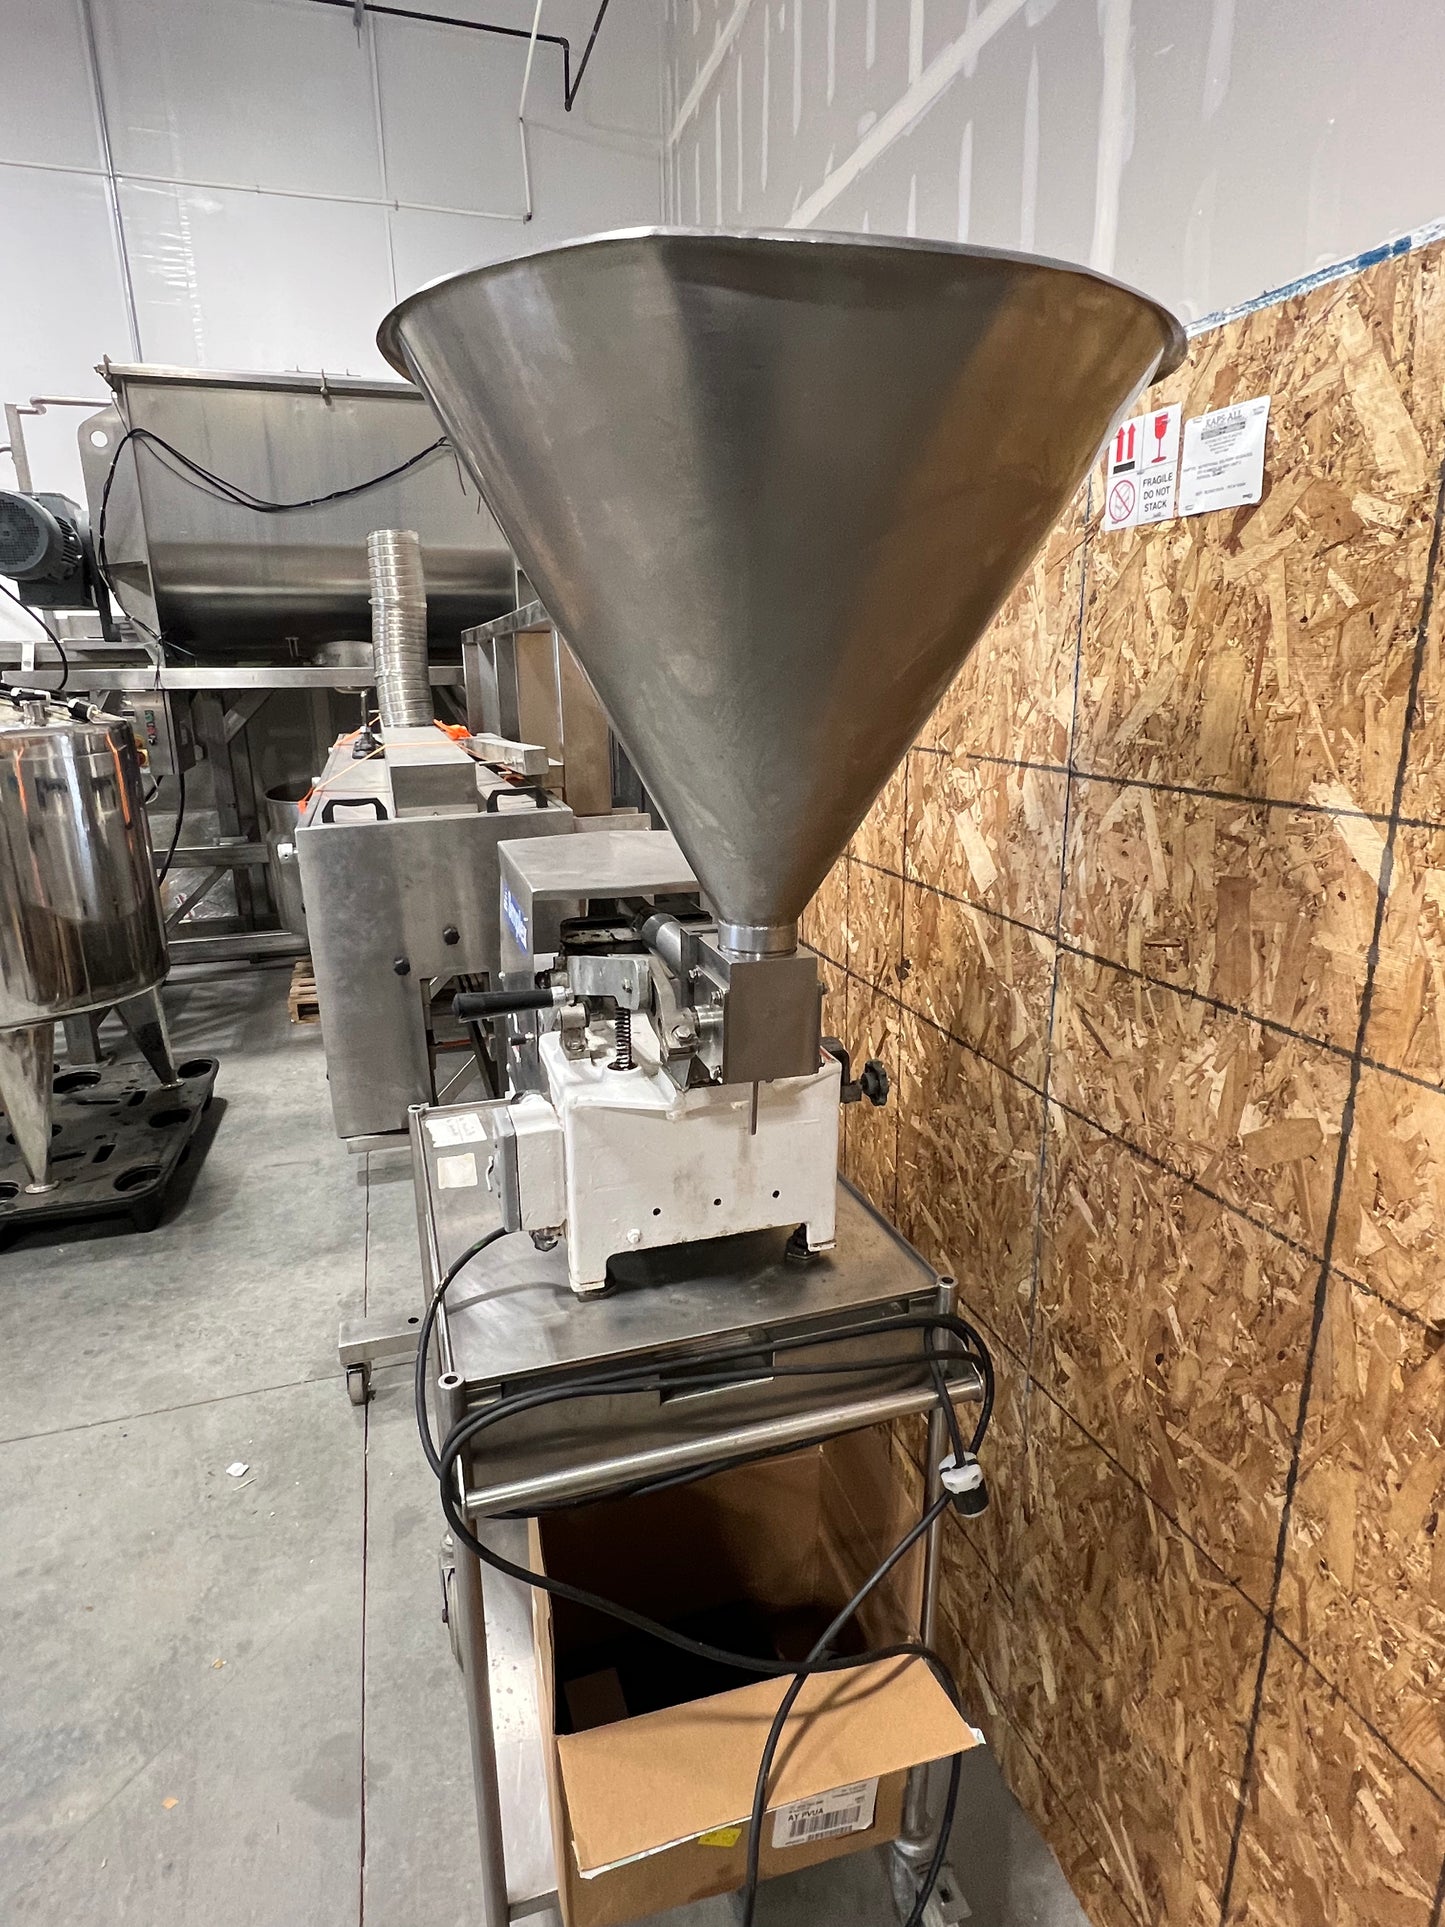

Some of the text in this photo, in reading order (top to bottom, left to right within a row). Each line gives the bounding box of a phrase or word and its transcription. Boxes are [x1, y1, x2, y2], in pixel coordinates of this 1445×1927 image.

[1143, 472, 1173, 488] FRAGILE
[1143, 485, 1171, 500] DO NOT
[1144, 500, 1167, 512] STACK
